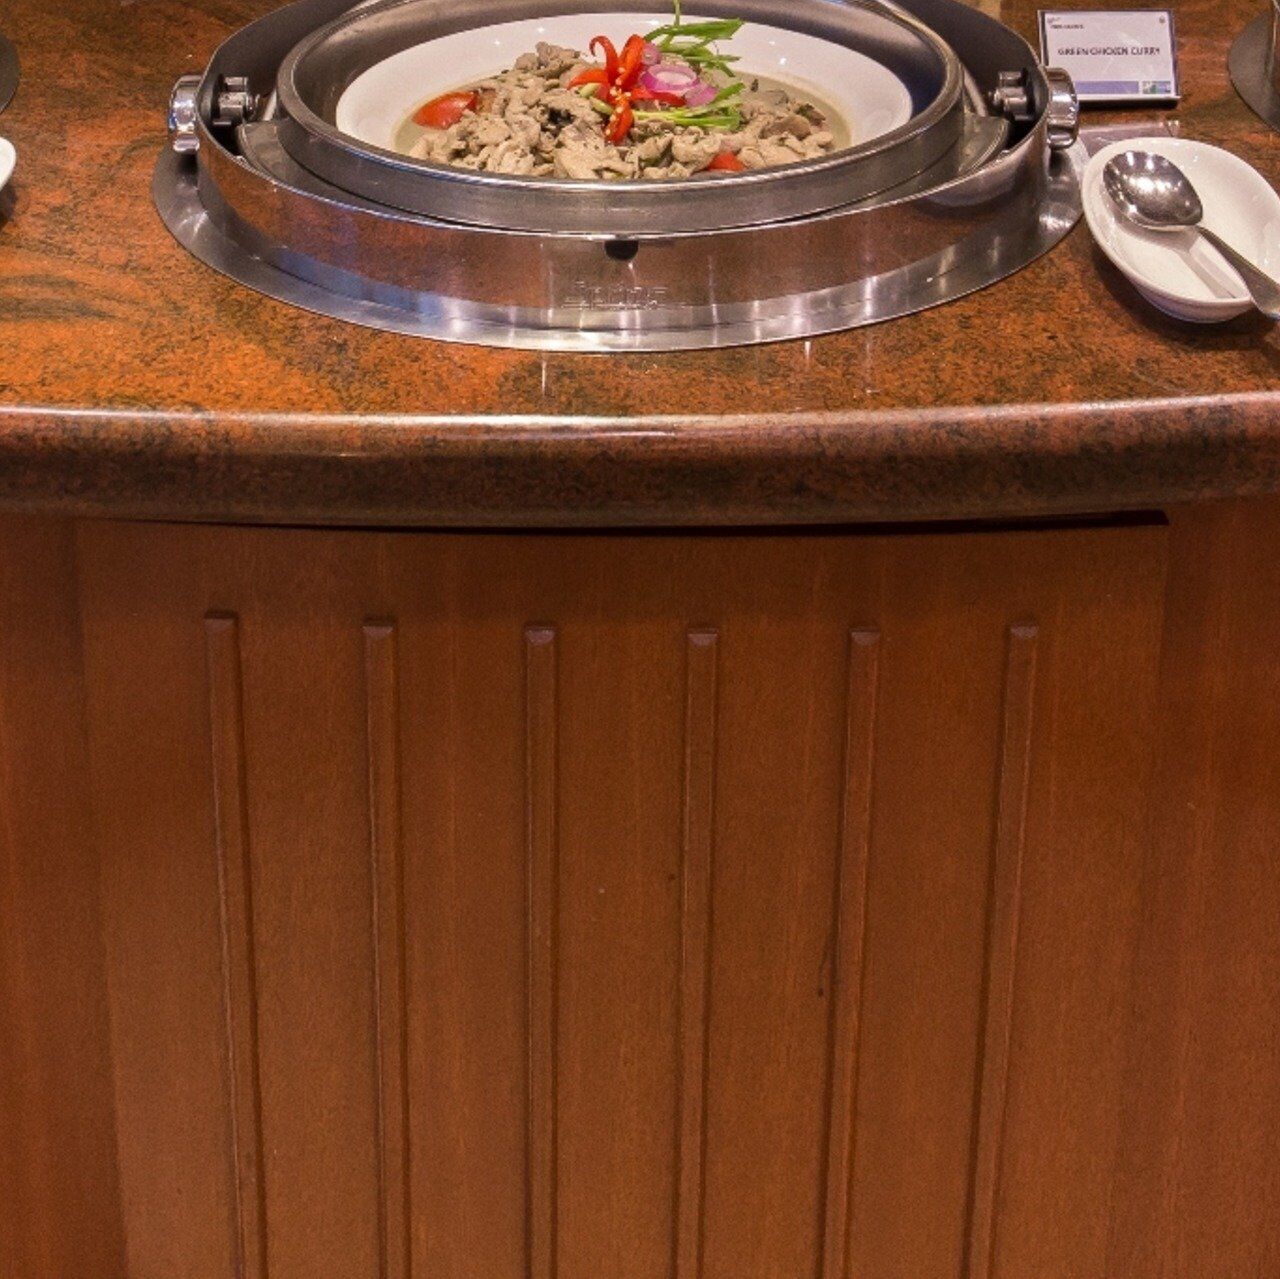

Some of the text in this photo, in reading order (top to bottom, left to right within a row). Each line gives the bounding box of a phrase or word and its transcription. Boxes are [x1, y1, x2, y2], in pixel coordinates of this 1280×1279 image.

[1058, 46, 1160, 56] GREEN CHICKEN CURRY
